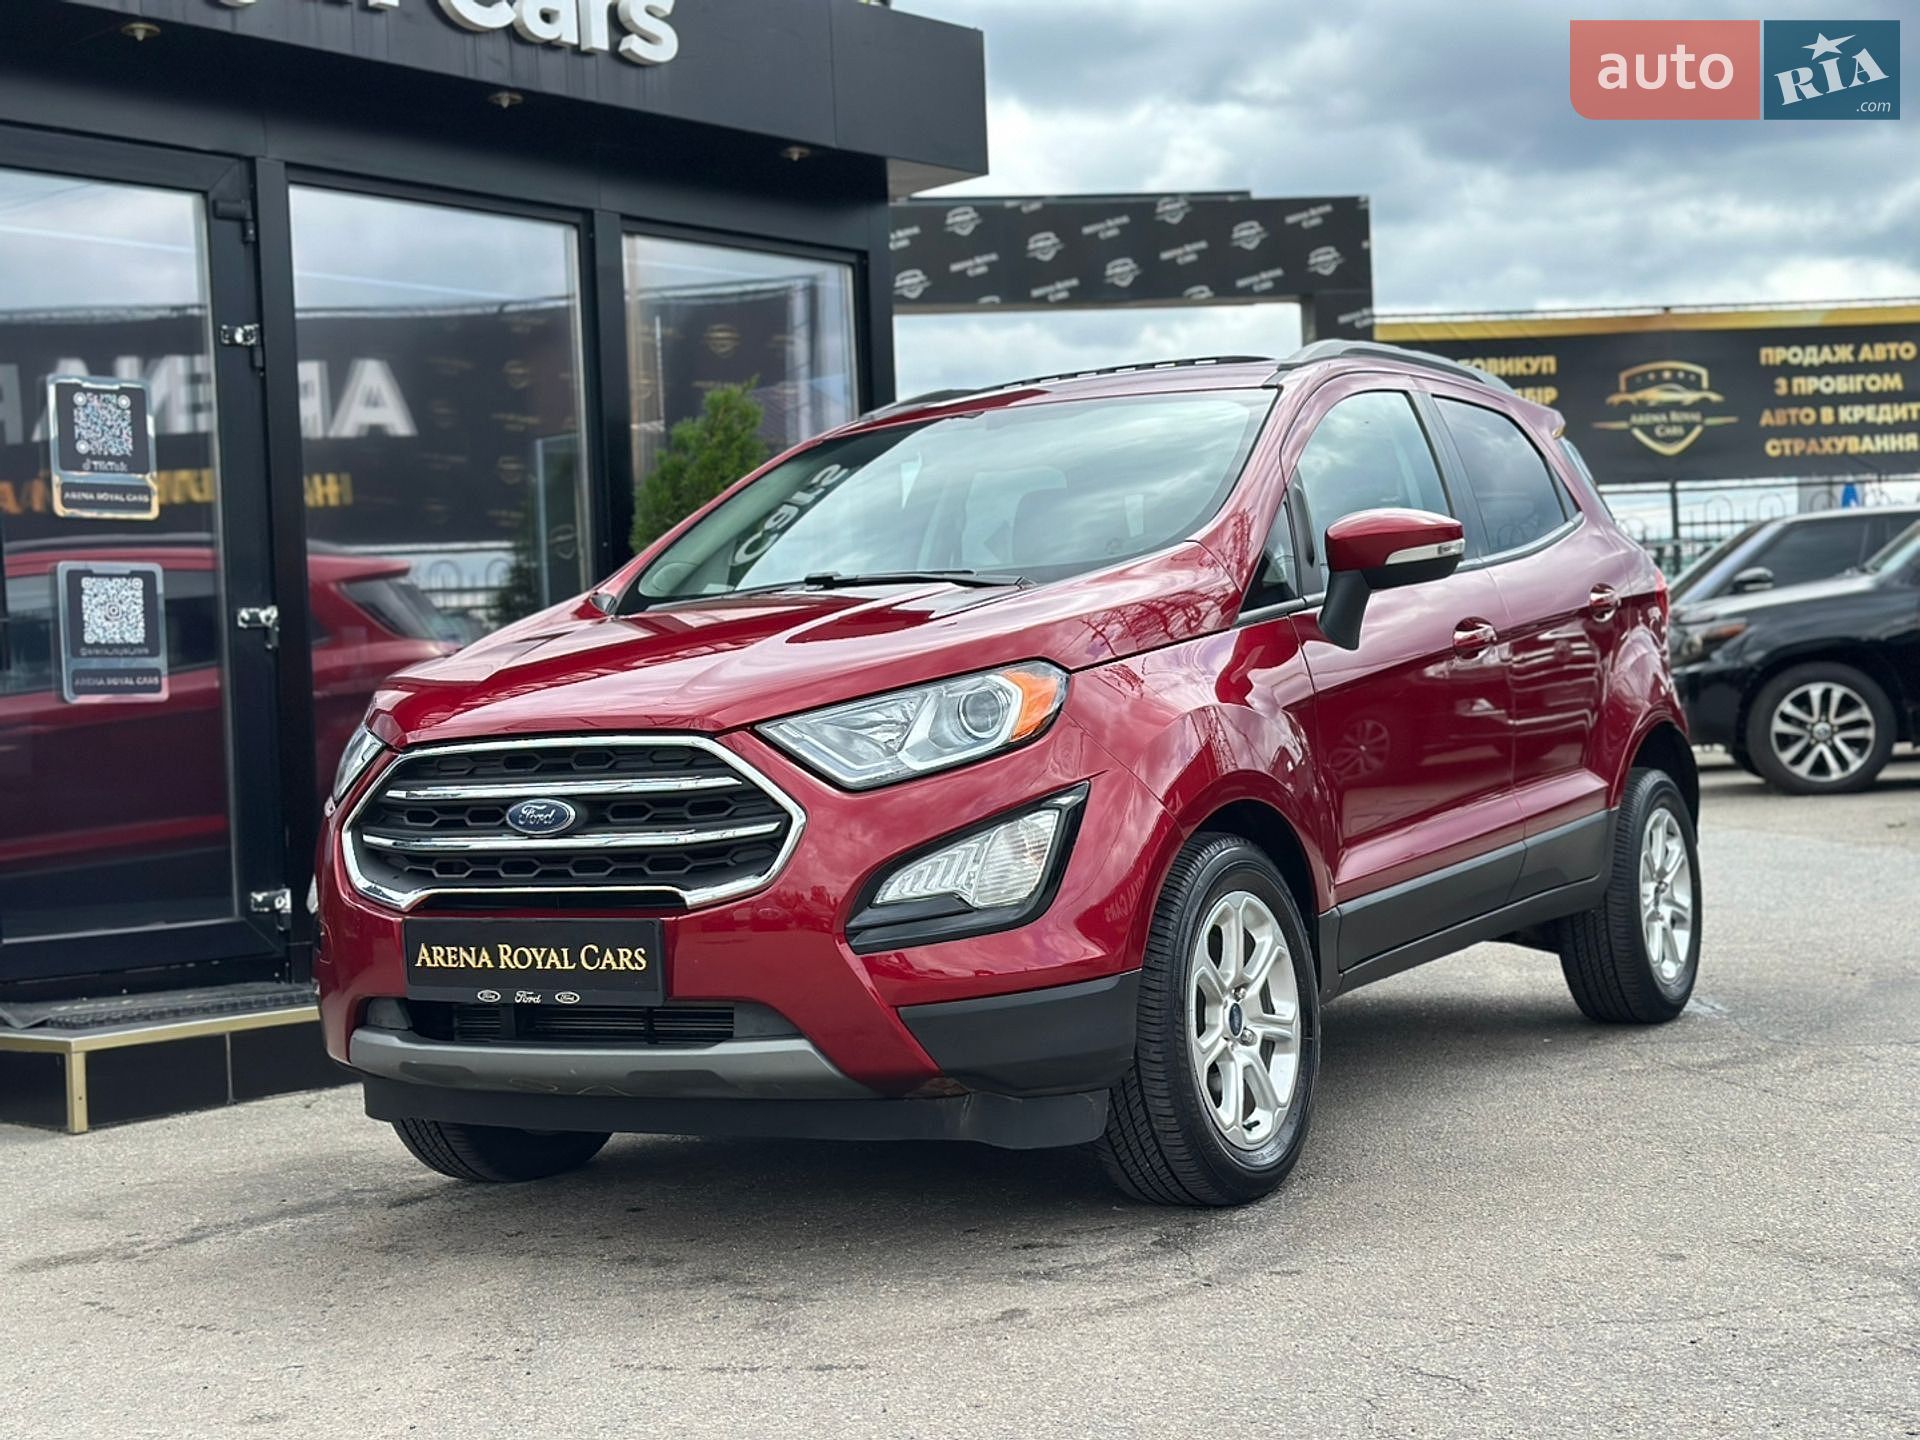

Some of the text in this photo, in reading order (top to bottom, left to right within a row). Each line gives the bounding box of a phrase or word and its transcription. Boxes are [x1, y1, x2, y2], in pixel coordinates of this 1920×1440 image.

[1759, 341, 1918, 367] ПРОДАЖ АВТО
[1791, 372, 1904, 395] ПРОБІГОМ
[1759, 402, 1920, 427] АВТО В КРЕДИТ
[1765, 432, 1919, 457] СТРАХУВАННЯ
[518, 804, 556, 825] Ford
[415, 943, 647, 970] ARENA ROYAL CARS
[514, 990, 541, 1004] Ford
